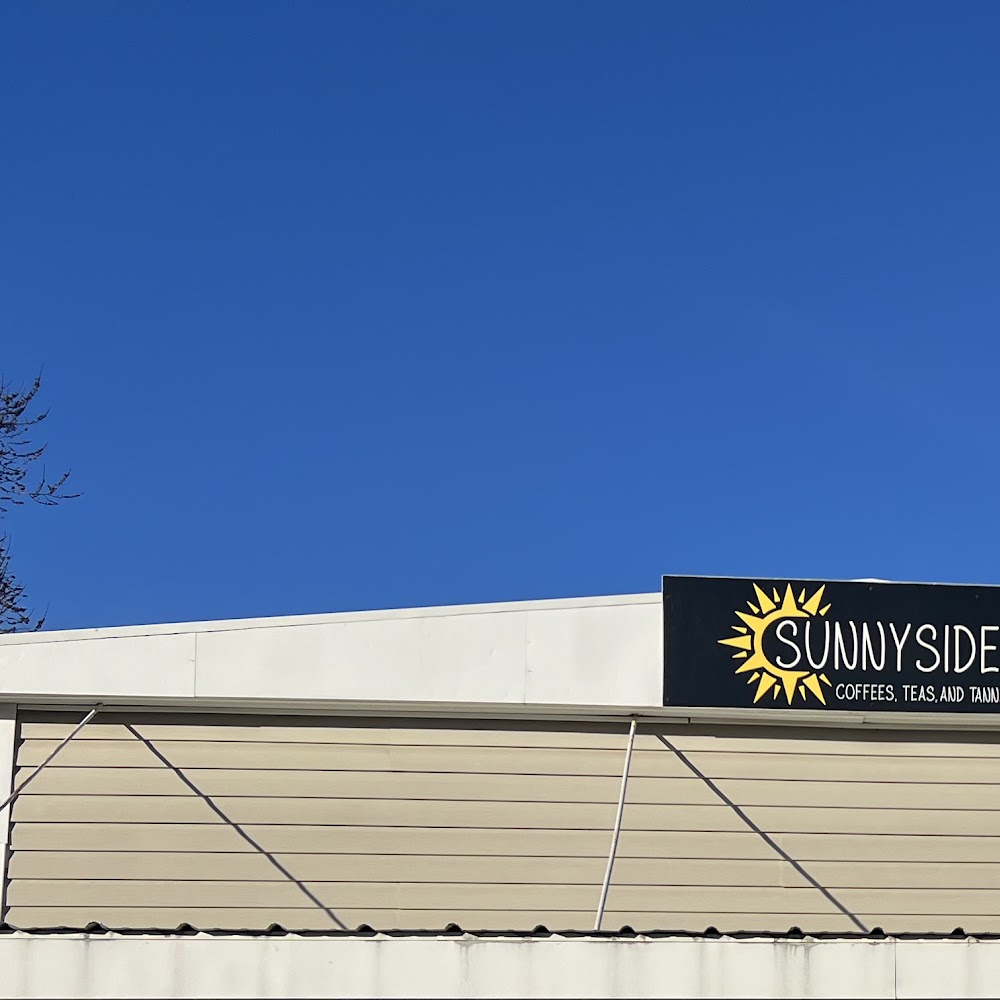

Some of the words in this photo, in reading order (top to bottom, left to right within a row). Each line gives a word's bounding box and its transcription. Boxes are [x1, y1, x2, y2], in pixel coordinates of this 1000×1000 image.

[776, 620, 1000, 673] SUNNYSIDE
[835, 683, 898, 703] COFFEES,
[902, 685, 938, 704] TEAS,
[940, 686, 965, 703] AND
